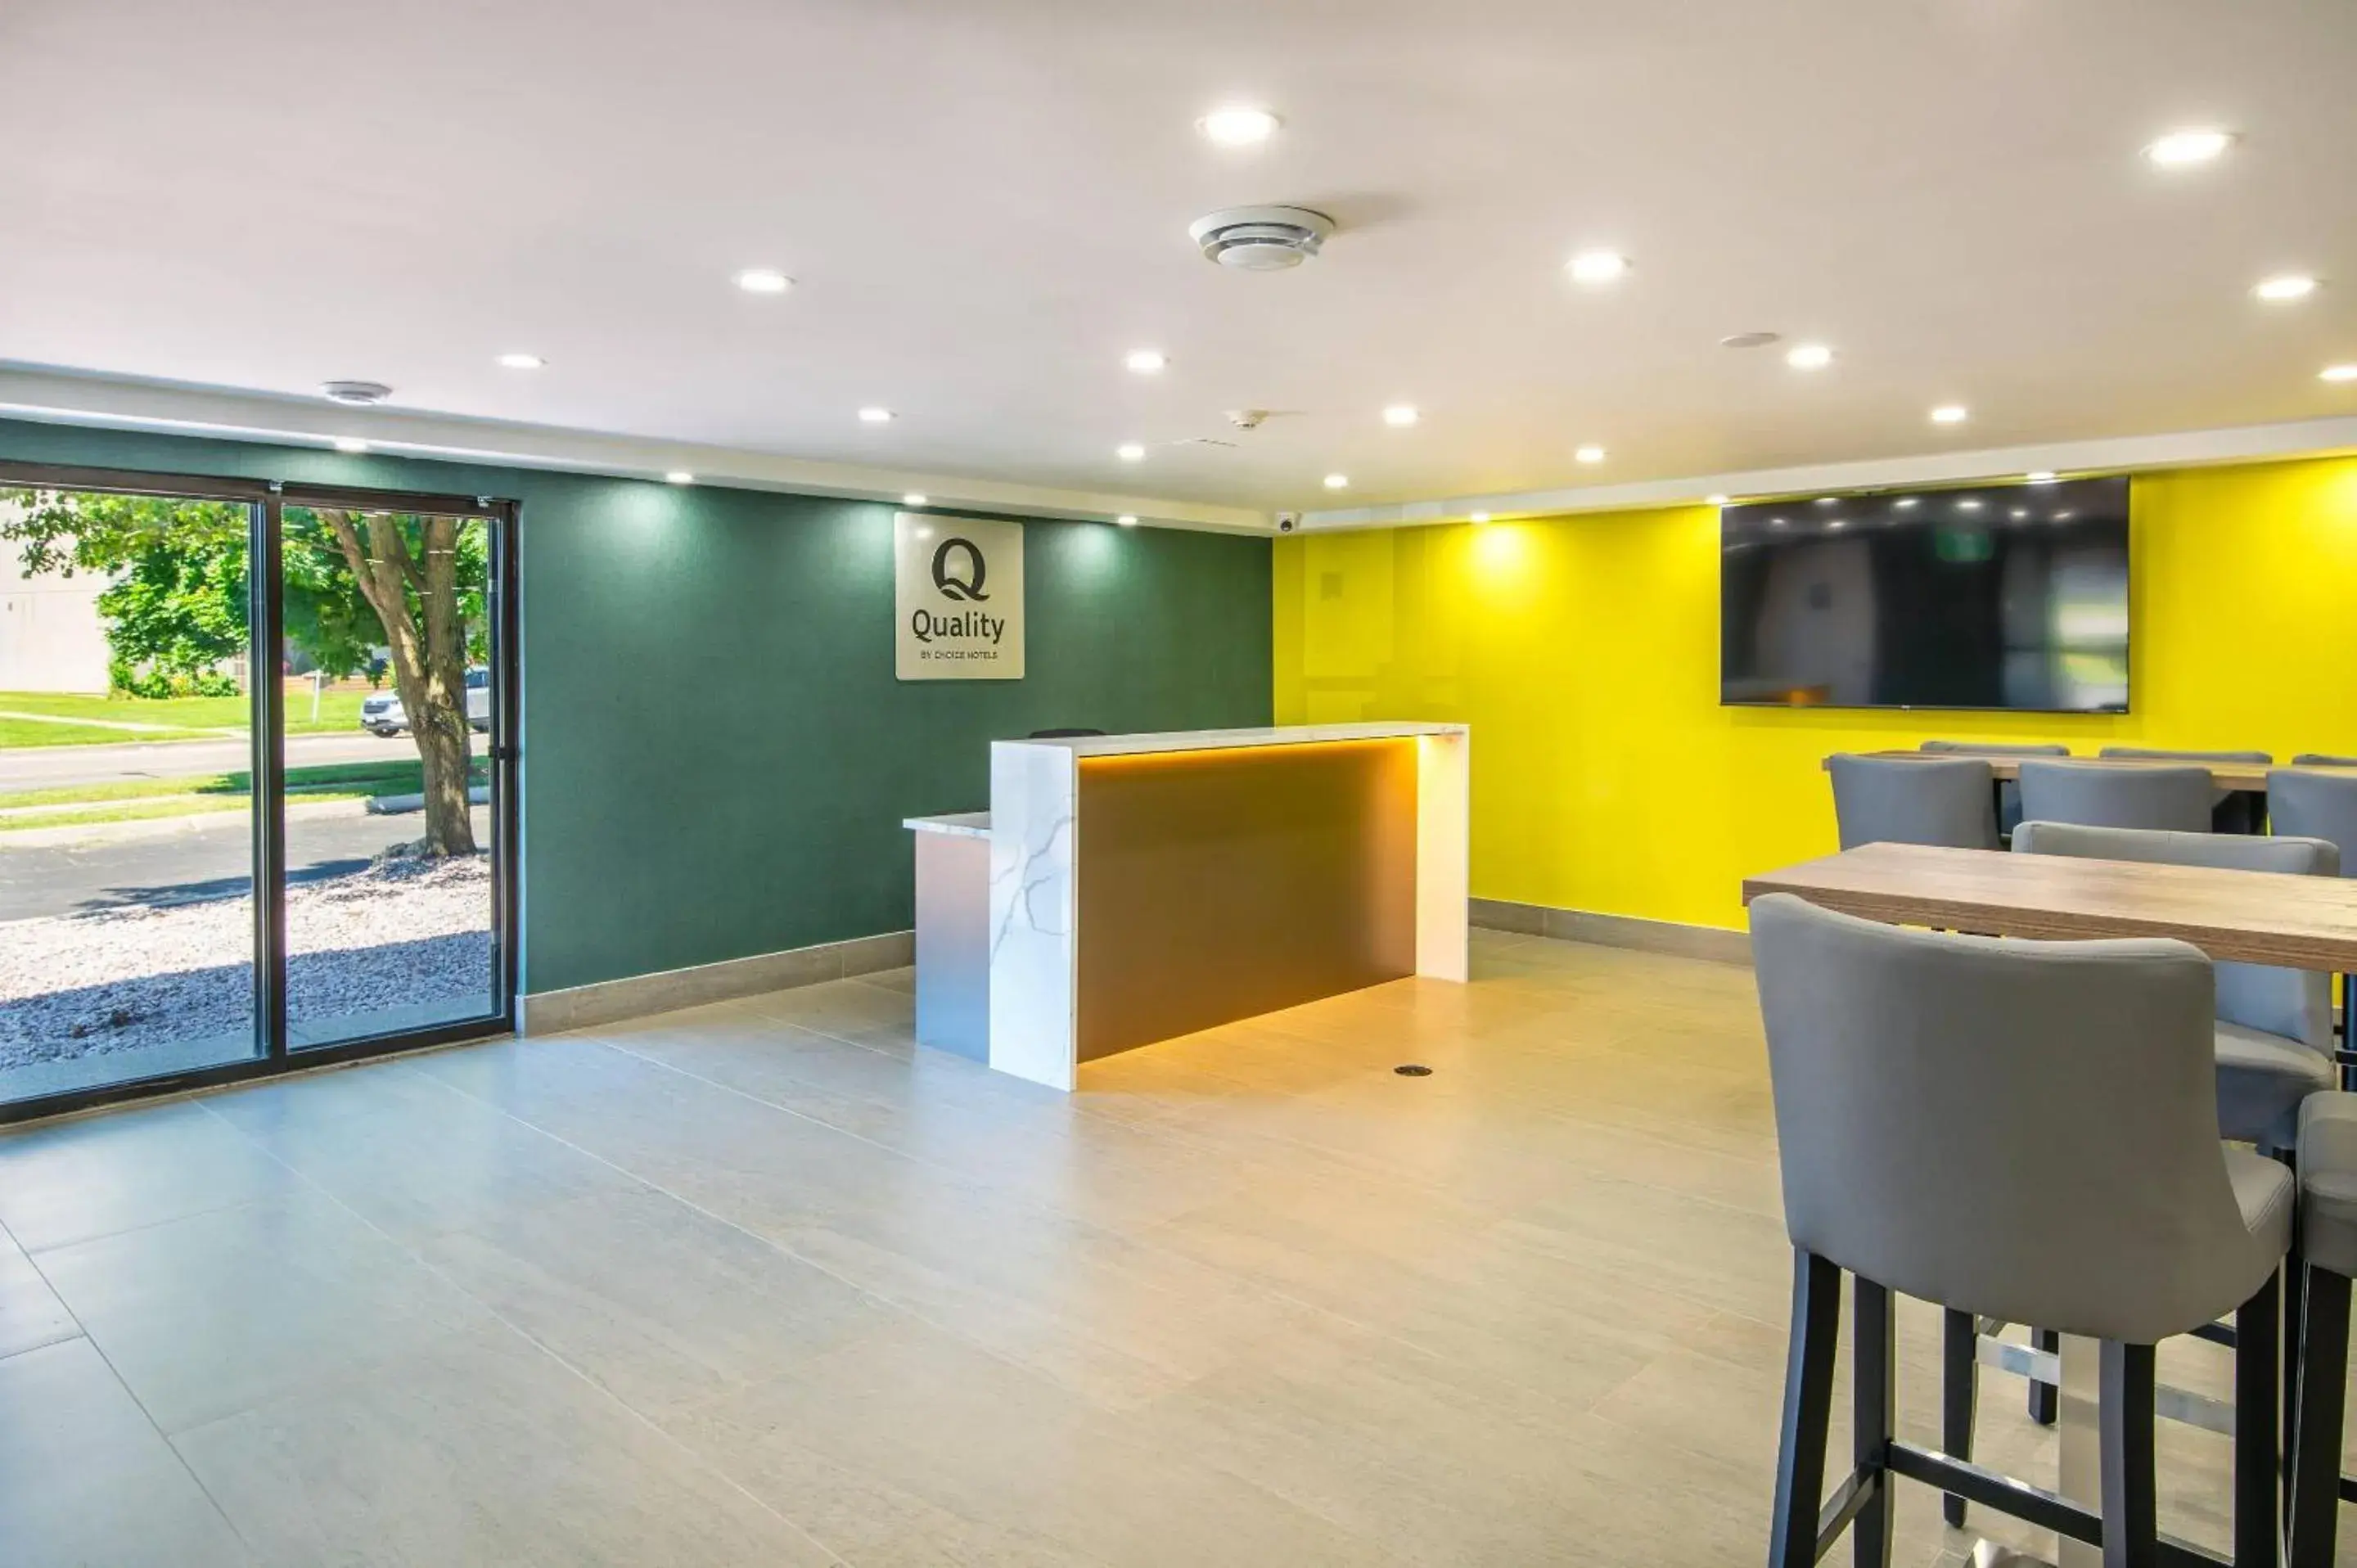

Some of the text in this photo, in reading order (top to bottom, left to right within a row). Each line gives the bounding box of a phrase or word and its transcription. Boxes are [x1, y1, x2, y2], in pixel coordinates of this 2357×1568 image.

[931, 538, 990, 601] Q
[912, 609, 1005, 644] Quality
[921, 650, 931, 659] BY
[967, 651, 998, 659] HOTELS
